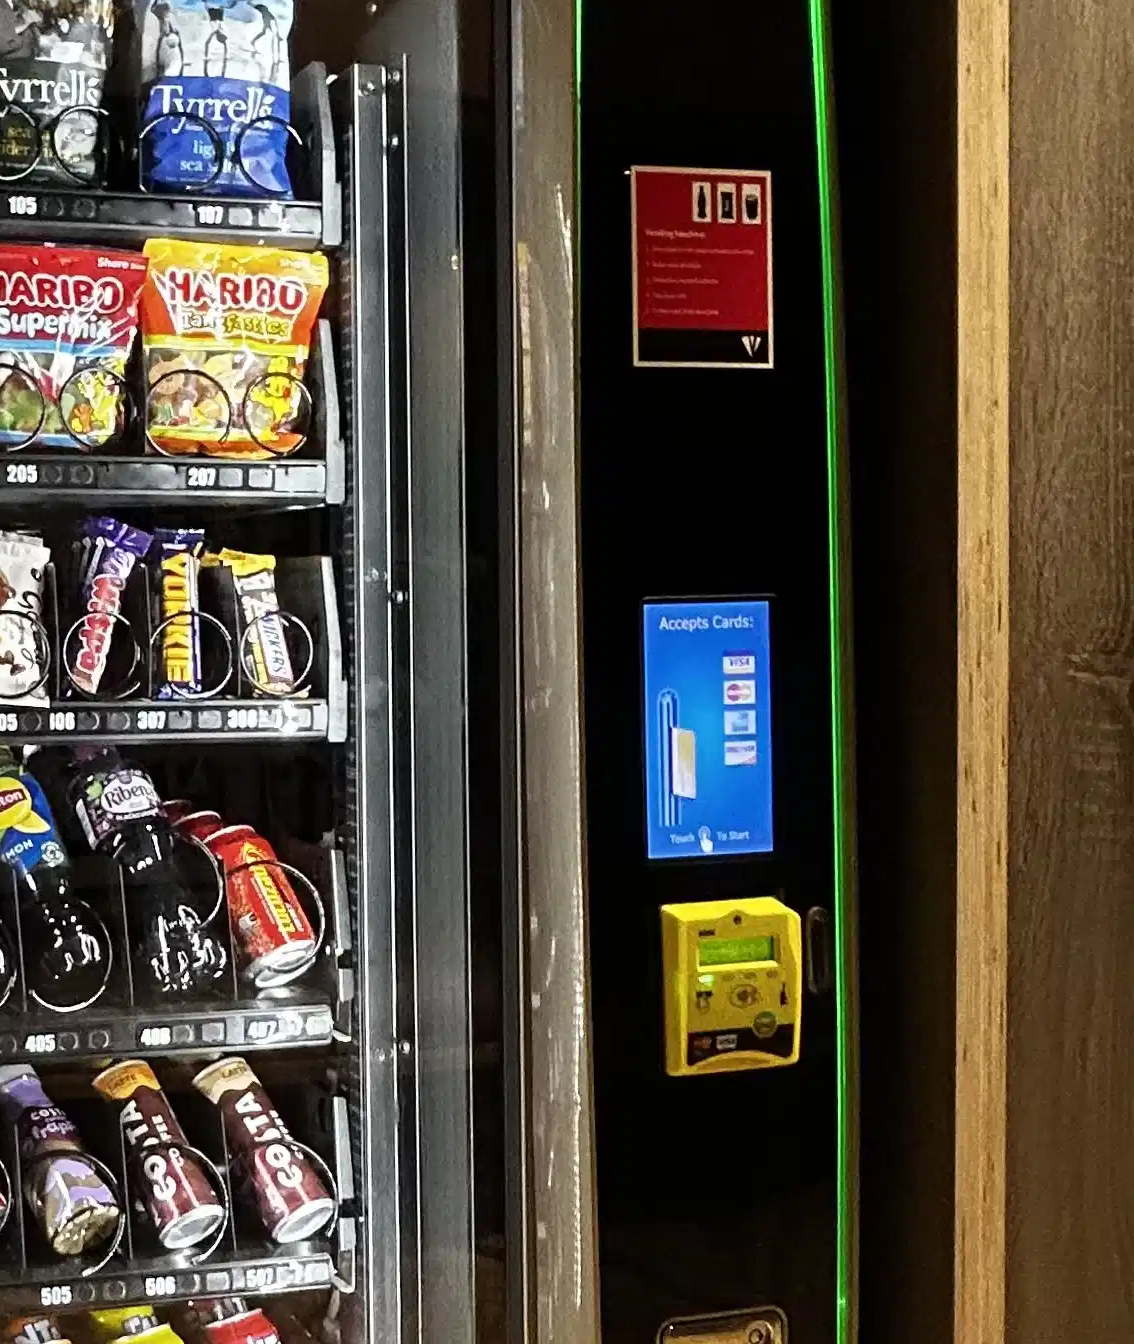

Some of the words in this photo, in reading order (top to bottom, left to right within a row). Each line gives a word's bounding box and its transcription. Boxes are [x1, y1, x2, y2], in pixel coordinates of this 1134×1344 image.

[150, 85, 275, 128] Tyrrells
[180, 158, 203, 172] sea
[8, 195, 37, 215] 105
[197, 205, 224, 225] 107
[167, 269, 306, 312] HARIBO
[7, 465, 37, 484] 205
[188, 467, 215, 487] 207
[659, 615, 709, 632] Accepts
[712, 614, 755, 630] Cards:
[262, 609, 287, 679] NICKERS
[728, 657, 751, 668] VISA
[137, 712, 166, 730] 307
[670, 832, 695, 845] Touch
[716, 830, 728, 841] To
[25, 1034, 56, 1053] 405
[41, 1286, 72, 1306] 505
[145, 1277, 176, 1297] 506
